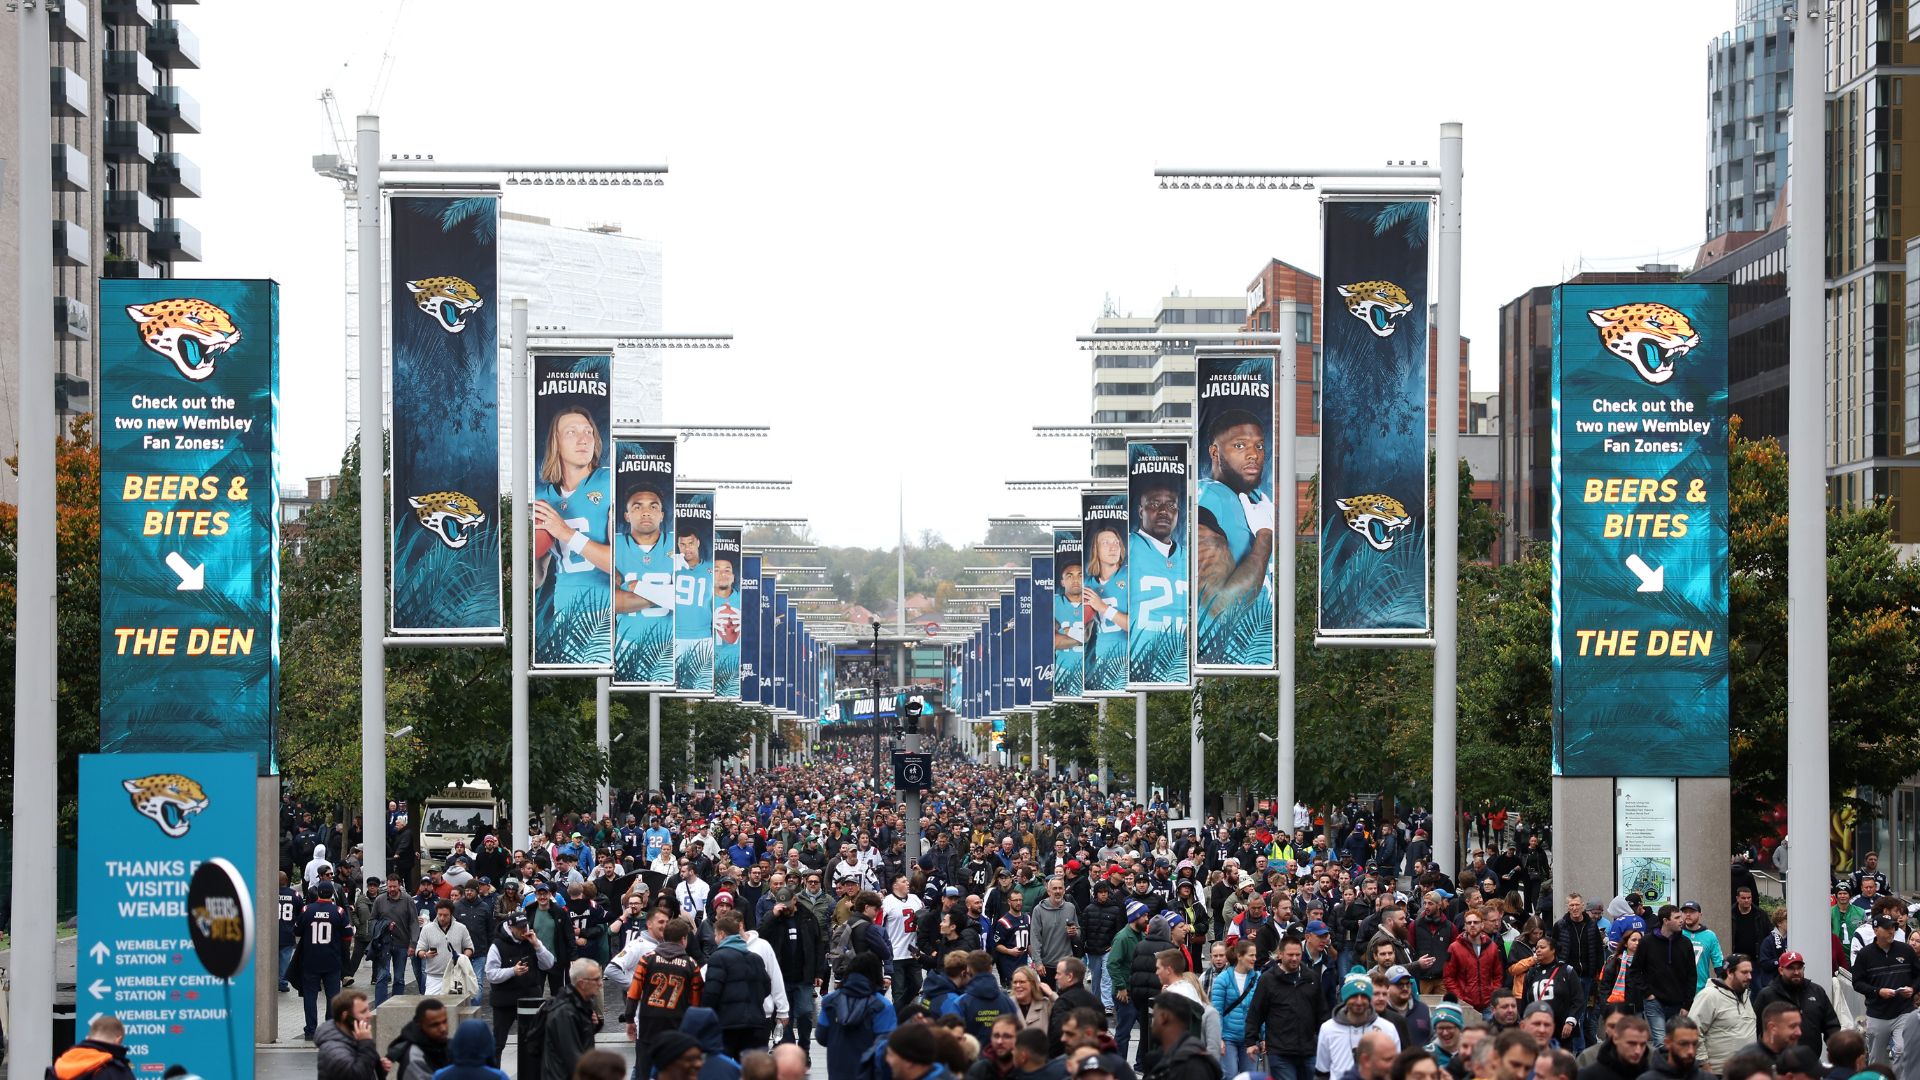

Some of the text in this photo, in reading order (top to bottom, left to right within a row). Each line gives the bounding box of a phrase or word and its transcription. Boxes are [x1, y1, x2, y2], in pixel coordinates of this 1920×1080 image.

[538, 380, 607, 396] JAGUARS
[1202, 382, 1269, 398] JAGUARS
[132, 395, 235, 410] Check out the
[1592, 399, 1694, 413] Check out the
[115, 415, 252, 432] two new Wembley
[1576, 419, 1711, 435] two new Wembley
[143, 436, 224, 450] Fan Zones:
[1604, 439, 1683, 453] Fan Zones:
[618, 460, 672, 473] JAGUARS
[1132, 462, 1185, 475] JAGUARS
[123, 475, 249, 500] BEERS &
[1584, 478, 1707, 503] BEERS &
[675, 508, 711, 520] AGUARS
[1084, 509, 1128, 521] JAGUARS
[143, 510, 230, 536] BITES
[1603, 513, 1690, 539] BITES
[714, 543, 740, 552] GUARS
[1056, 544, 1082, 553] JAGUA
[1034, 578, 1053, 586] veriz
[675, 575, 706, 607] 91
[115, 628, 255, 656] THE DEN
[1576, 630, 1713, 657] THE DEN
[854, 696, 898, 715] DUUVAL!
[649, 836, 663, 848] 22
[1217, 850, 1228, 861] 12
[106, 861, 184, 877] THANKS
[974, 870, 986, 884] 43
[126, 881, 190, 897] VISITIN
[118, 901, 189, 917] WEMBL
[279, 903, 293, 921] 8
[314, 911, 330, 919] JONES
[310, 921, 332, 945] 10
[1841, 922, 1850, 945] 1
[115, 940, 195, 951] WEMBLEY PA
[1014, 929, 1029, 952] 10
[115, 954, 166, 965] STATION
[115, 976, 177, 987] WEMBLEY
[115, 990, 166, 1001] STATION
[648, 973, 685, 1009] 27
[115, 1010, 177, 1021] WEMBLEY
[124, 1024, 166, 1035] TATION
[127, 1045, 149, 1056] XIS
